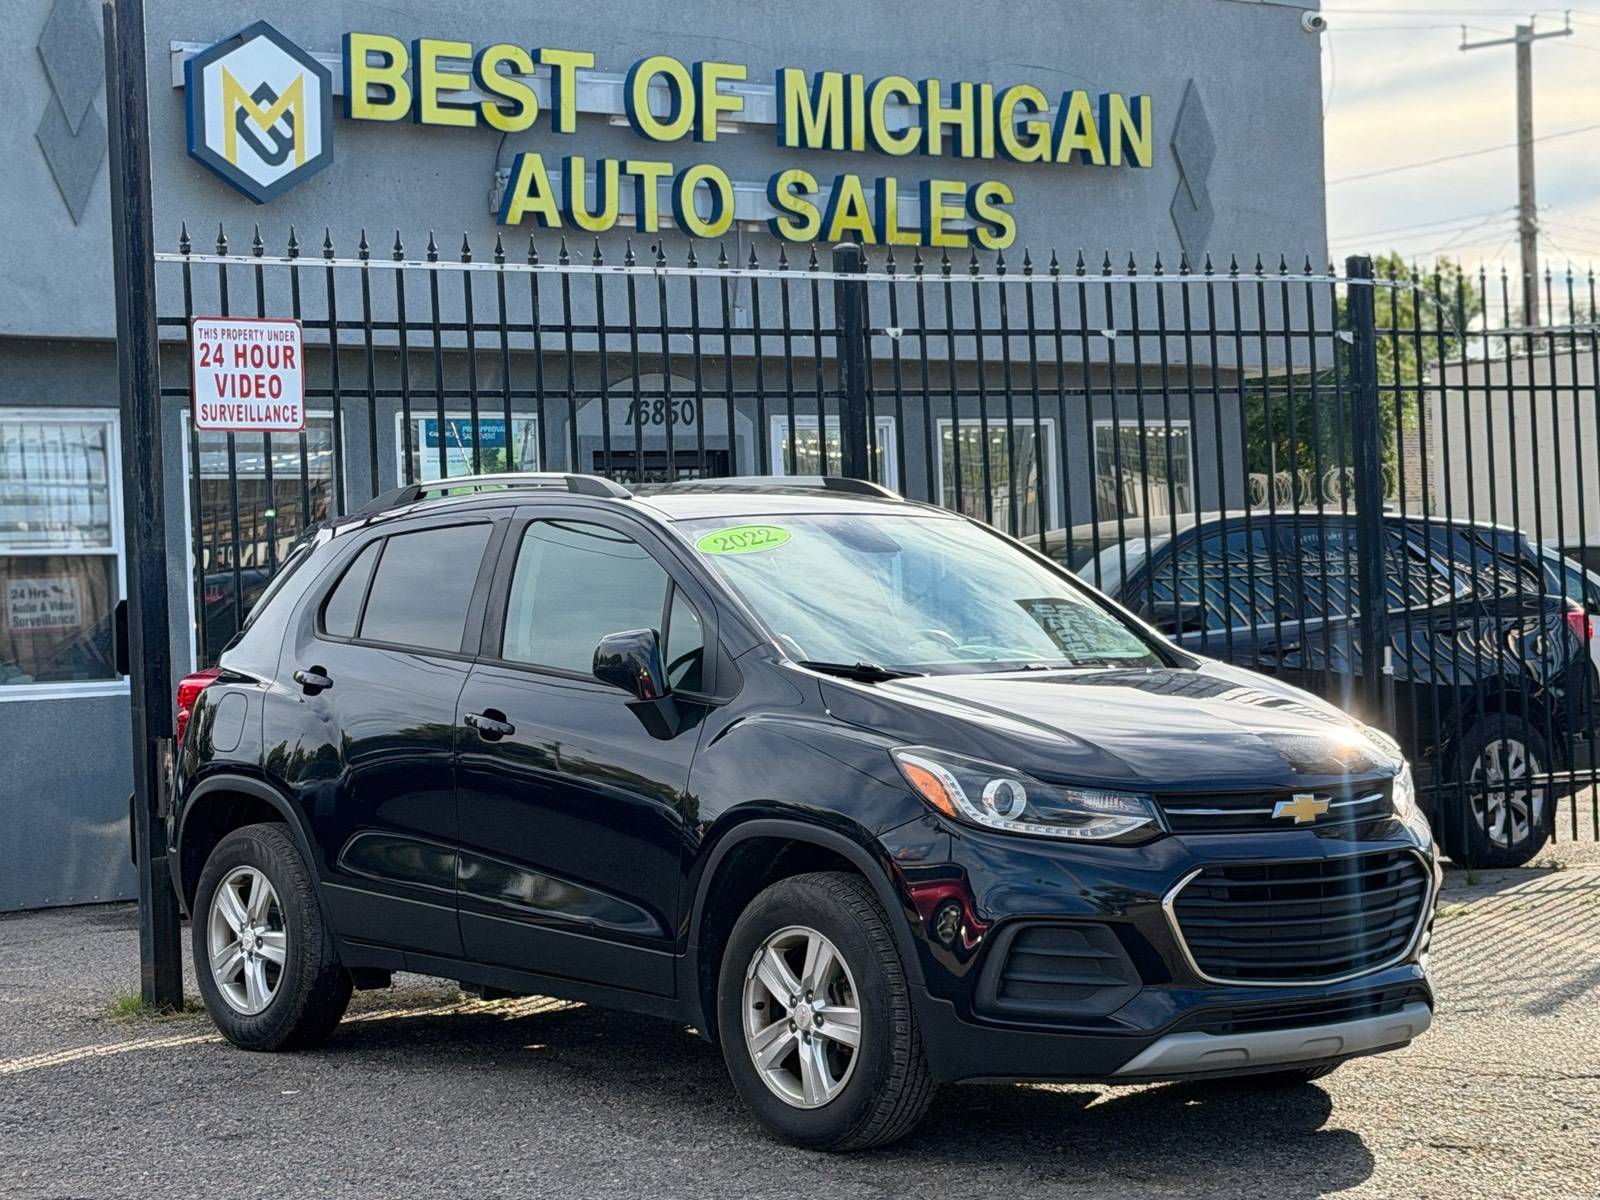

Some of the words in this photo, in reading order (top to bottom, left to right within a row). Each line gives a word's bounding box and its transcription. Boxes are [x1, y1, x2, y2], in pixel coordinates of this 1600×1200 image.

[344, 31, 595, 134] BEST
[625, 55, 748, 143] OF
[777, 67, 1153, 169] MICHIGAN
[500, 152, 736, 239] AUTO
[769, 169, 1017, 251] SALES
[198, 327, 219, 340] THIS
[221, 328, 265, 341] PROPERTY
[267, 329, 296, 343] UNDER
[199, 342, 225, 368] 24
[234, 343, 297, 370] HOUR
[214, 373, 283, 400] VIDEO
[201, 403, 299, 423] SURVEILLANCE
[624, 399, 695, 426] 16850
[712, 528, 779, 552] 2022
[10, 589, 25, 600] 24
[12, 614, 76, 627] Surveillance
